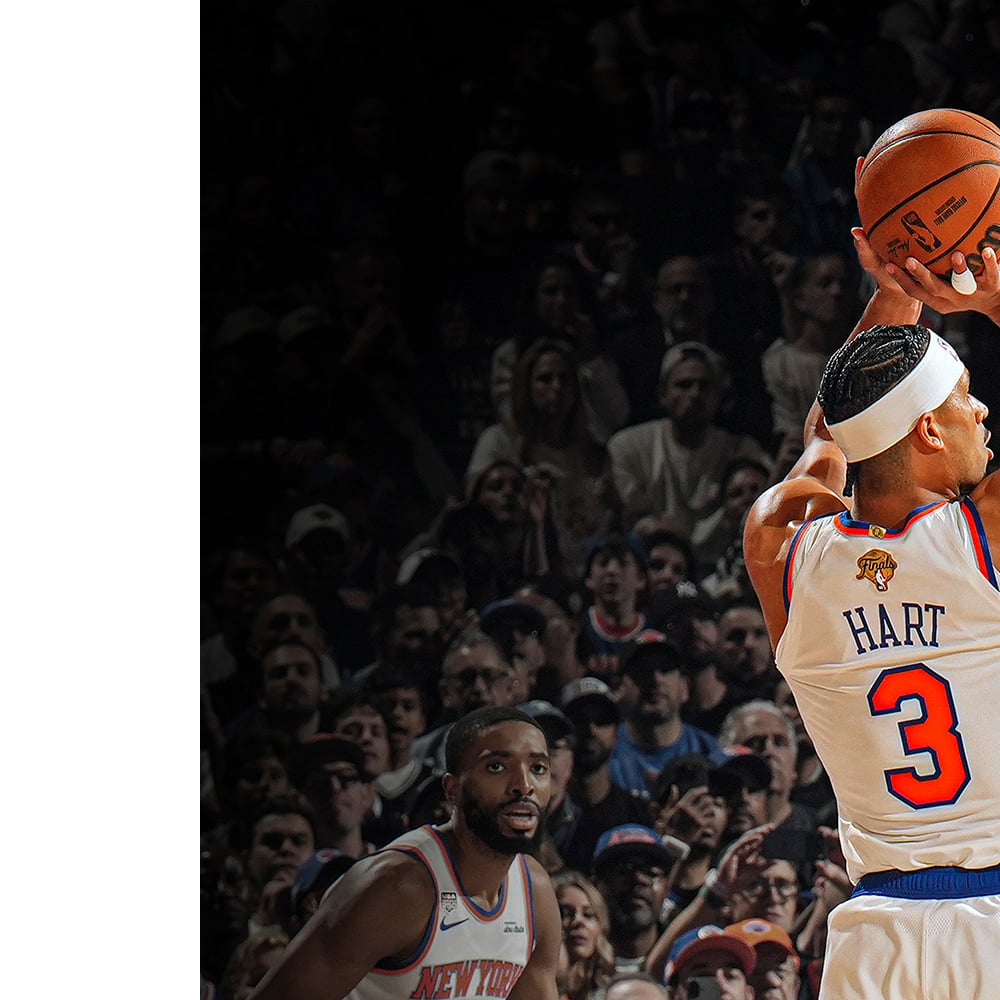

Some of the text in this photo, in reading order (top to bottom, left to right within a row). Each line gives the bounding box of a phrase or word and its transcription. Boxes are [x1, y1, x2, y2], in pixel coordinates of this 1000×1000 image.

[856, 555, 898, 579] Finals
[842, 602, 946, 655] HART
[866, 662, 972, 810] 3
[410, 960, 479, 1000] NEW
